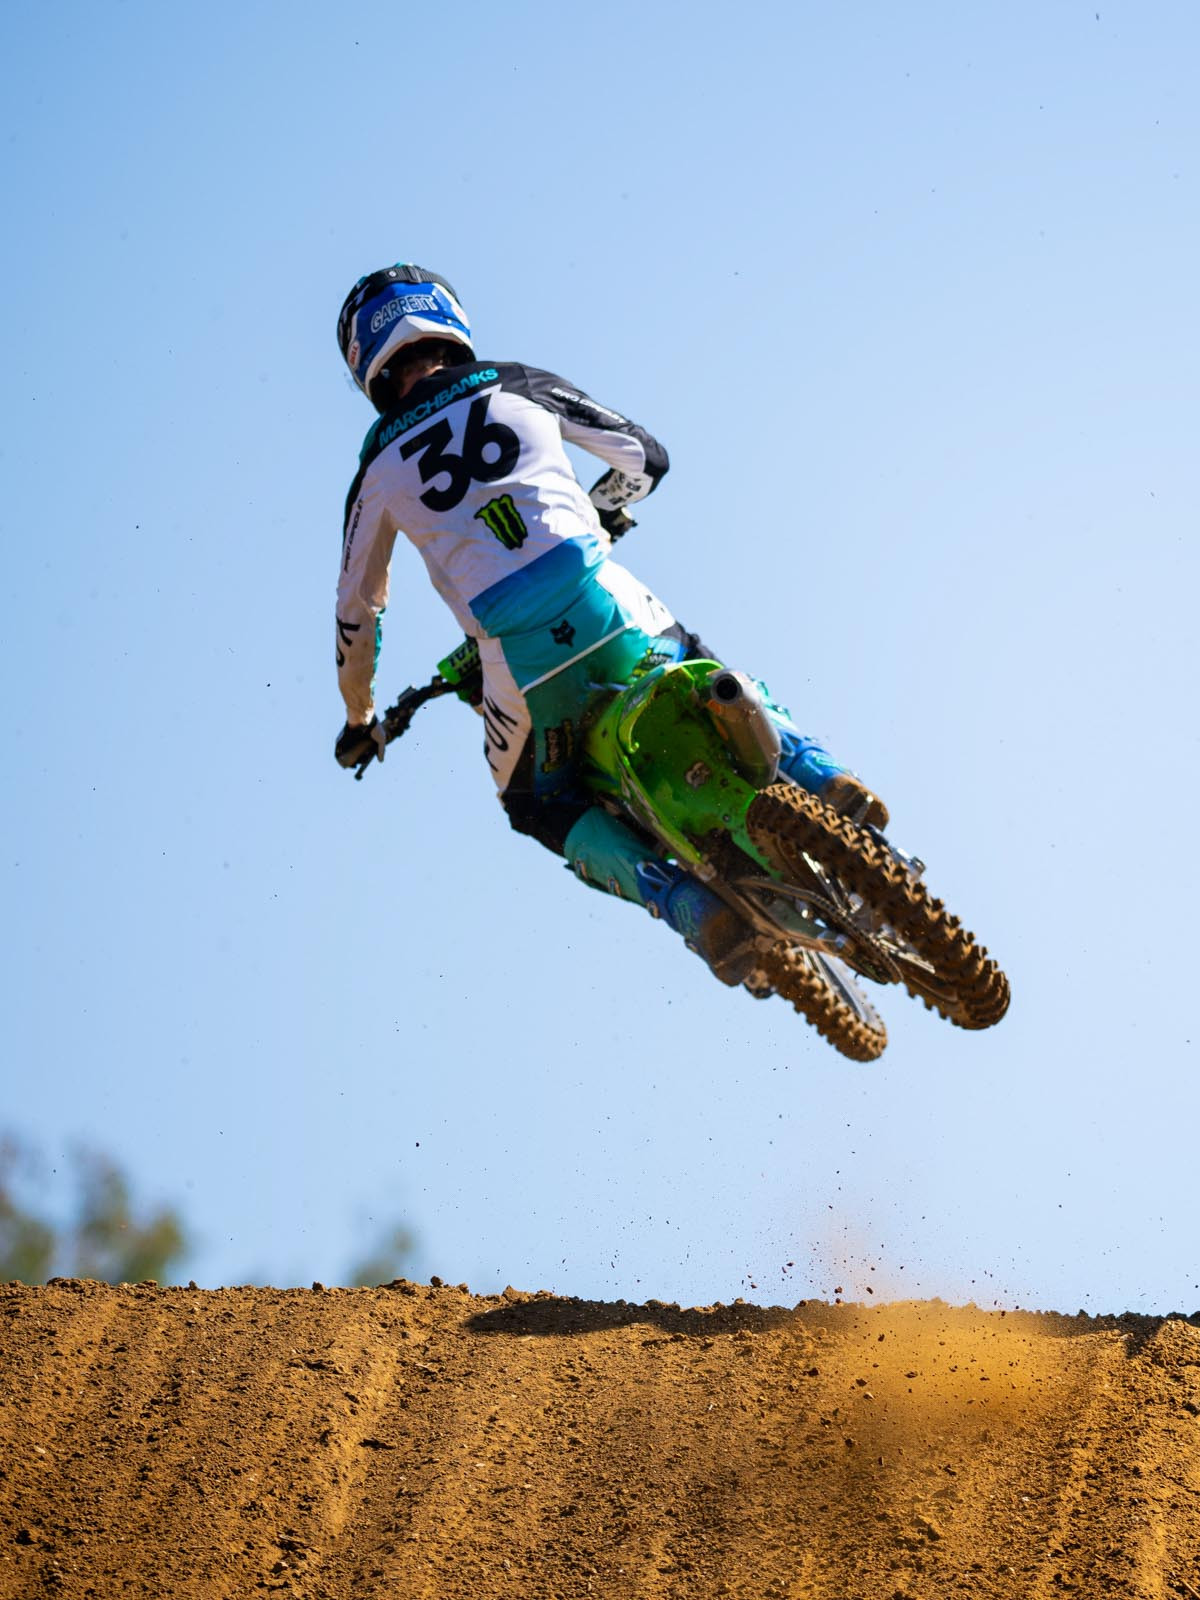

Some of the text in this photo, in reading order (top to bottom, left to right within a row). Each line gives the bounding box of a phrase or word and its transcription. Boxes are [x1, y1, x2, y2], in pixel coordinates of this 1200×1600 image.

[371, 294, 438, 333] GARRETT
[379, 368, 499, 448] MARCHBANKS
[399, 393, 520, 513] 36
